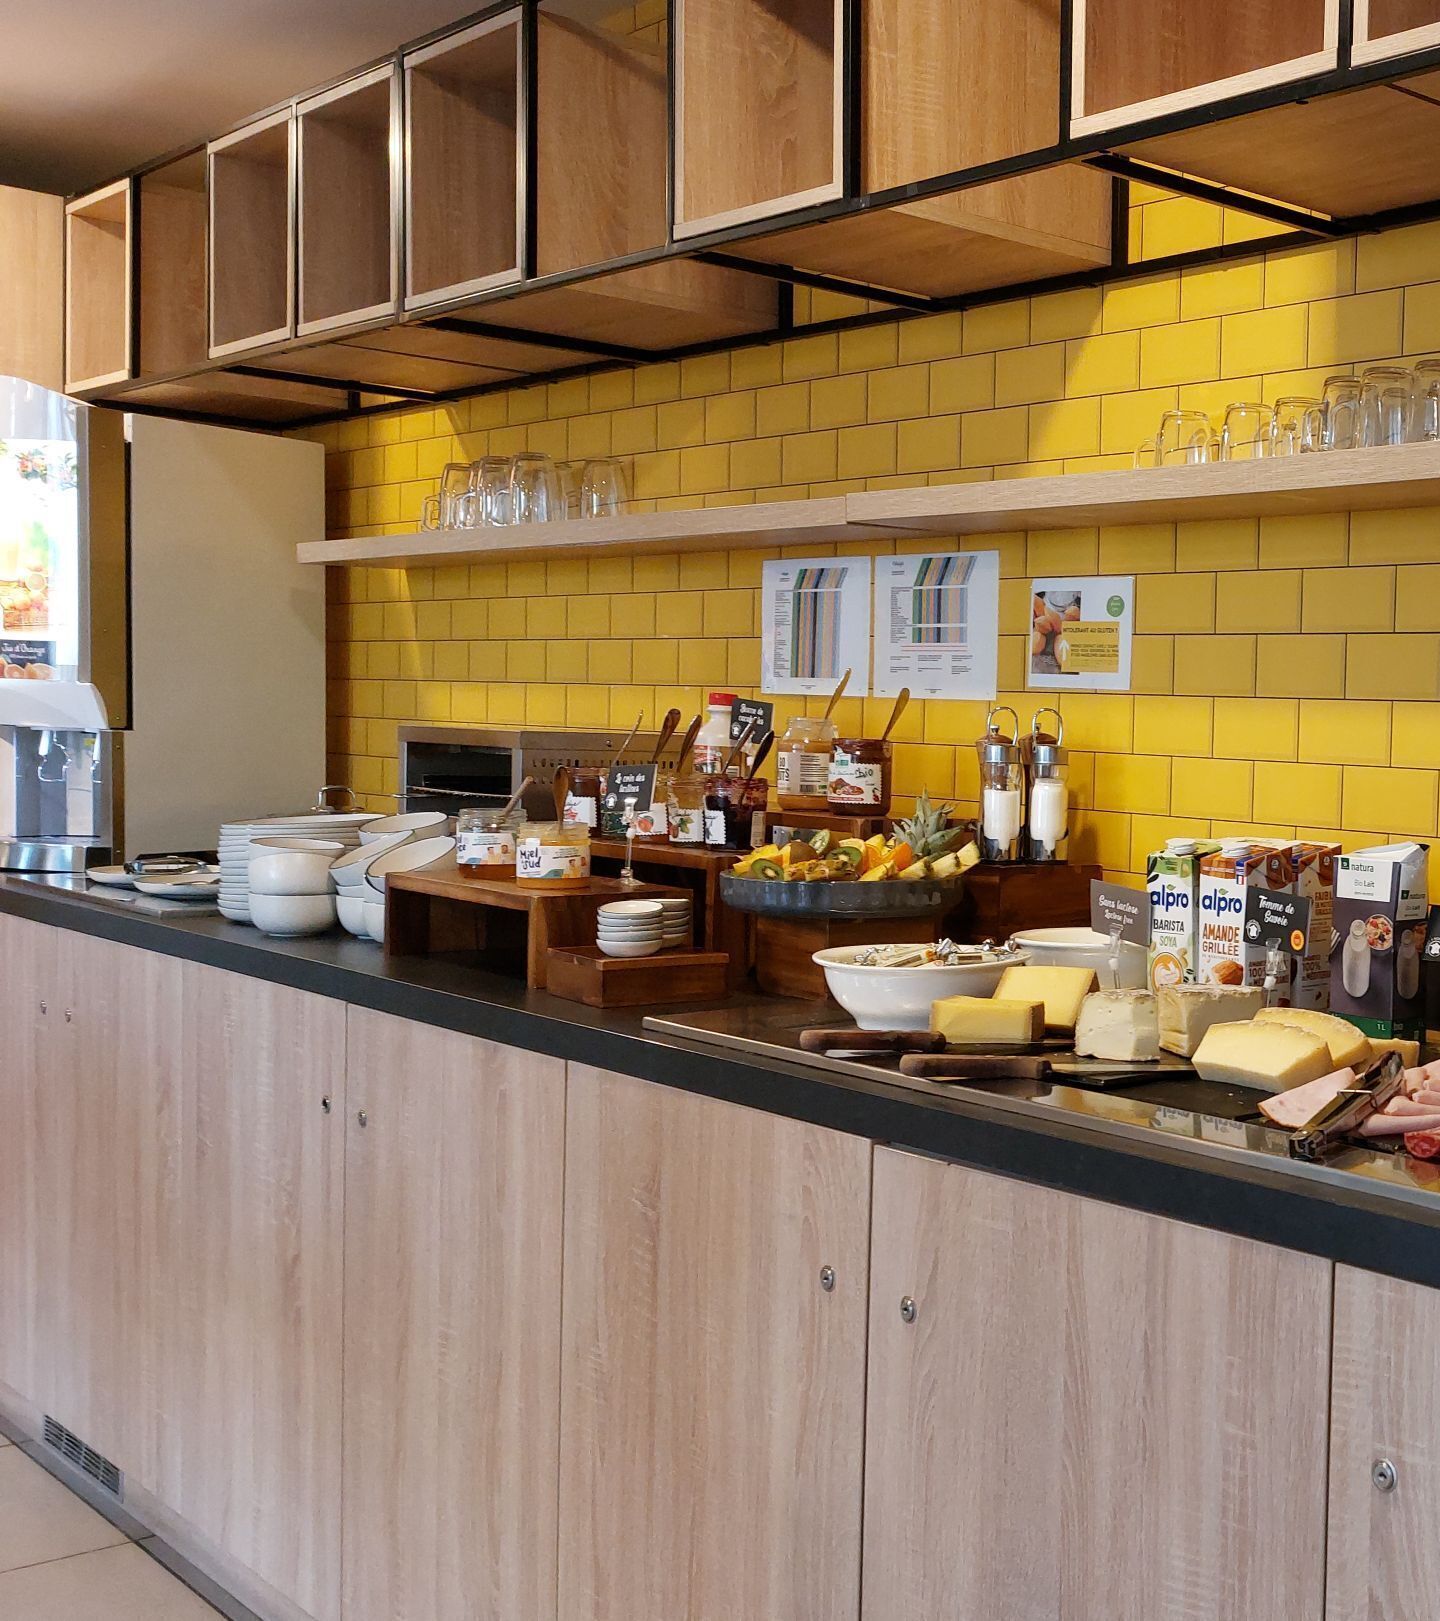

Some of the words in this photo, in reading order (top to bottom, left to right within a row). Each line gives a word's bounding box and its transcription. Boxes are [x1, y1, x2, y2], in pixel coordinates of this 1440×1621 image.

[1351, 863, 1374, 873] natura
[1364, 880, 1375, 888] Lait
[1150, 884, 1189, 912] alpro
[1202, 888, 1242, 917] alpro
[1258, 895, 1284, 912] Tomme
[1285, 903, 1295, 914] de
[1153, 919, 1185, 932] BARISTA
[1264, 910, 1289, 927] Savoie
[1202, 922, 1240, 943] AMANDE
[1160, 935, 1178, 947] SOYA
[1202, 941, 1240, 957] GRILLÉE
